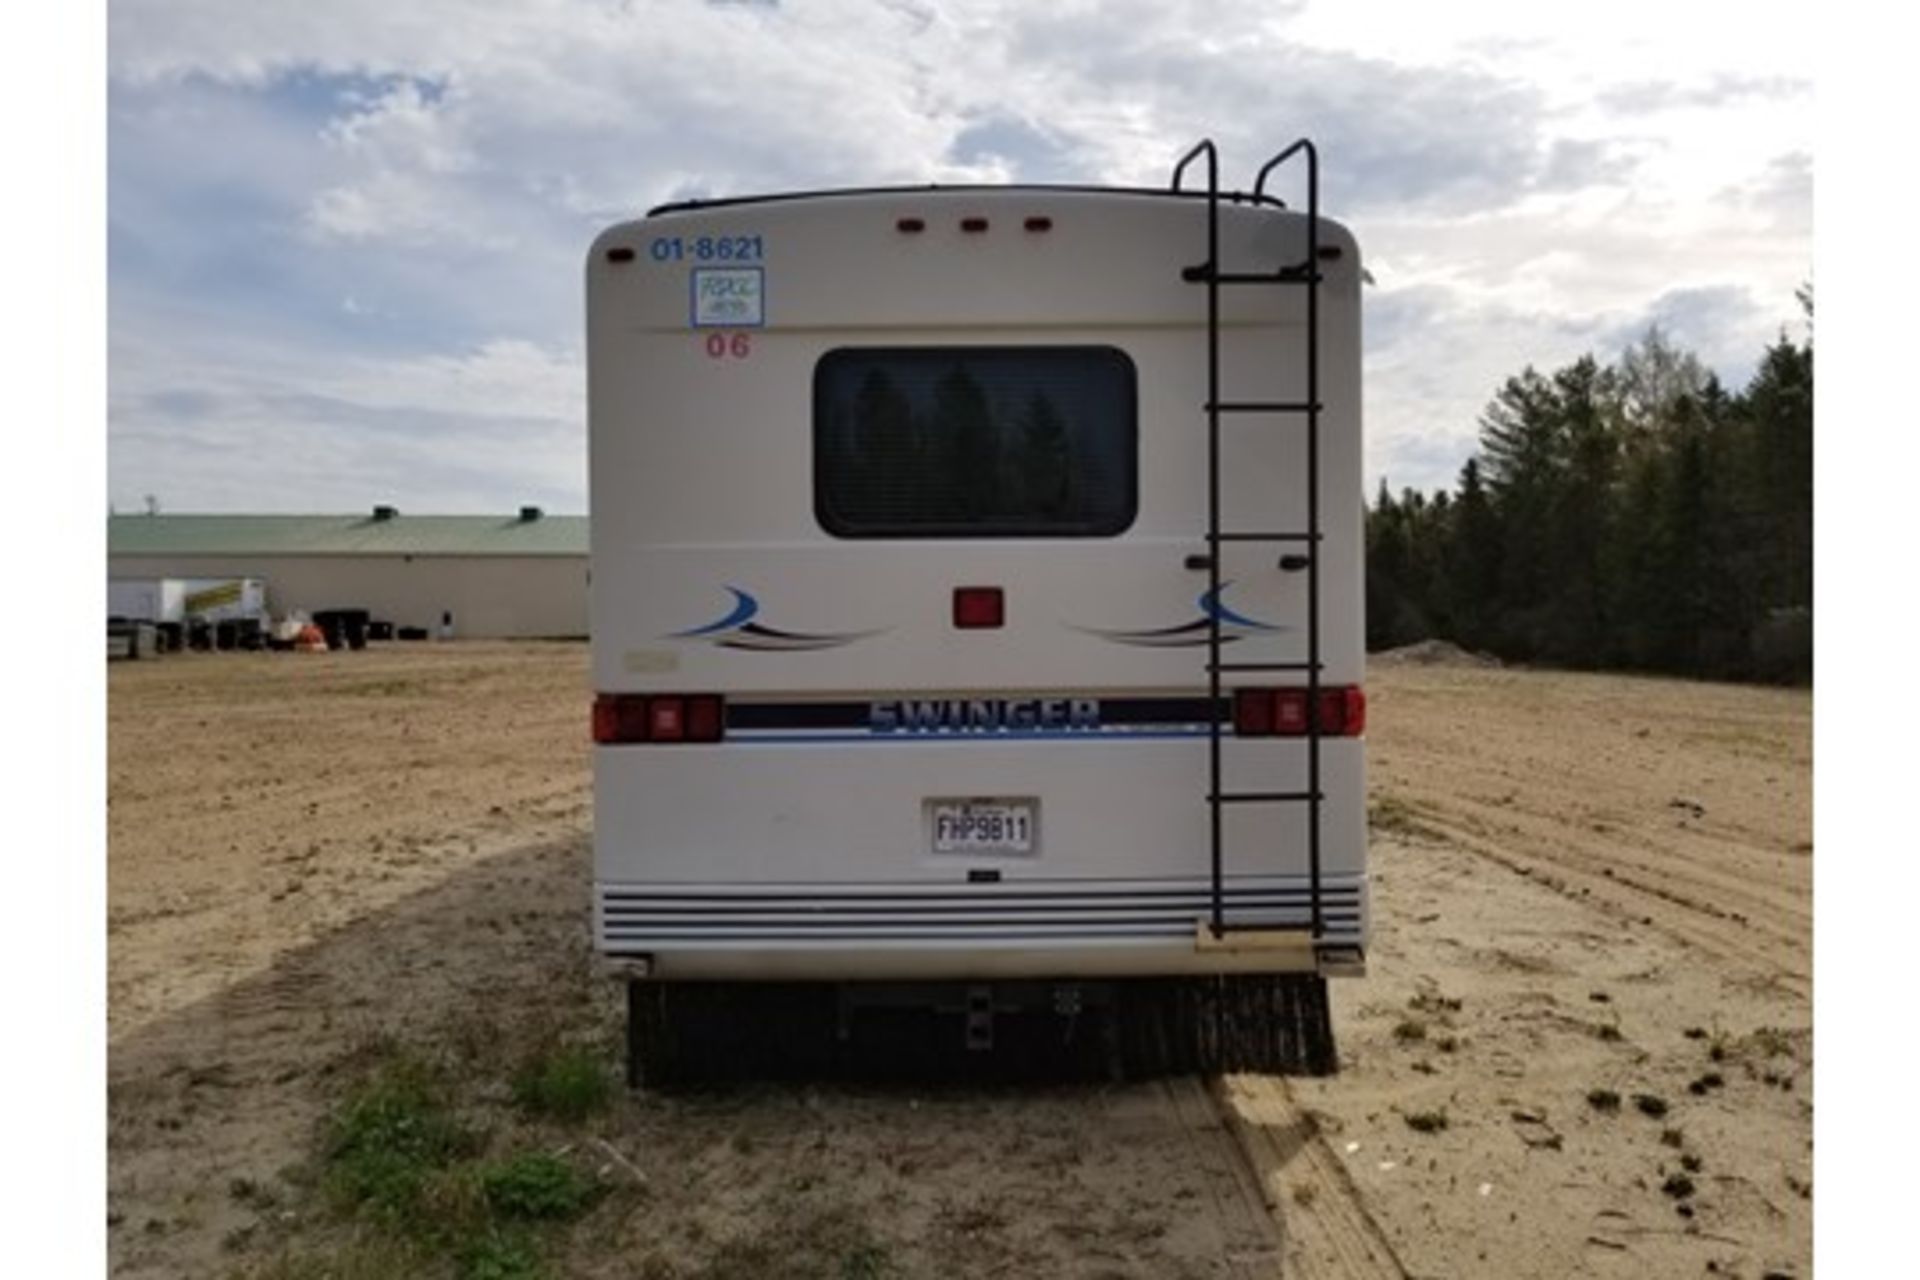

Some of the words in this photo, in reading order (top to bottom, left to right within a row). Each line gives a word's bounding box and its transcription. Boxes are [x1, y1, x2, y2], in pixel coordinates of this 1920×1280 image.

[652, 235, 764, 261] 01-8621
[706, 333, 750, 358] 06
[868, 699, 1100, 732] SWINGER
